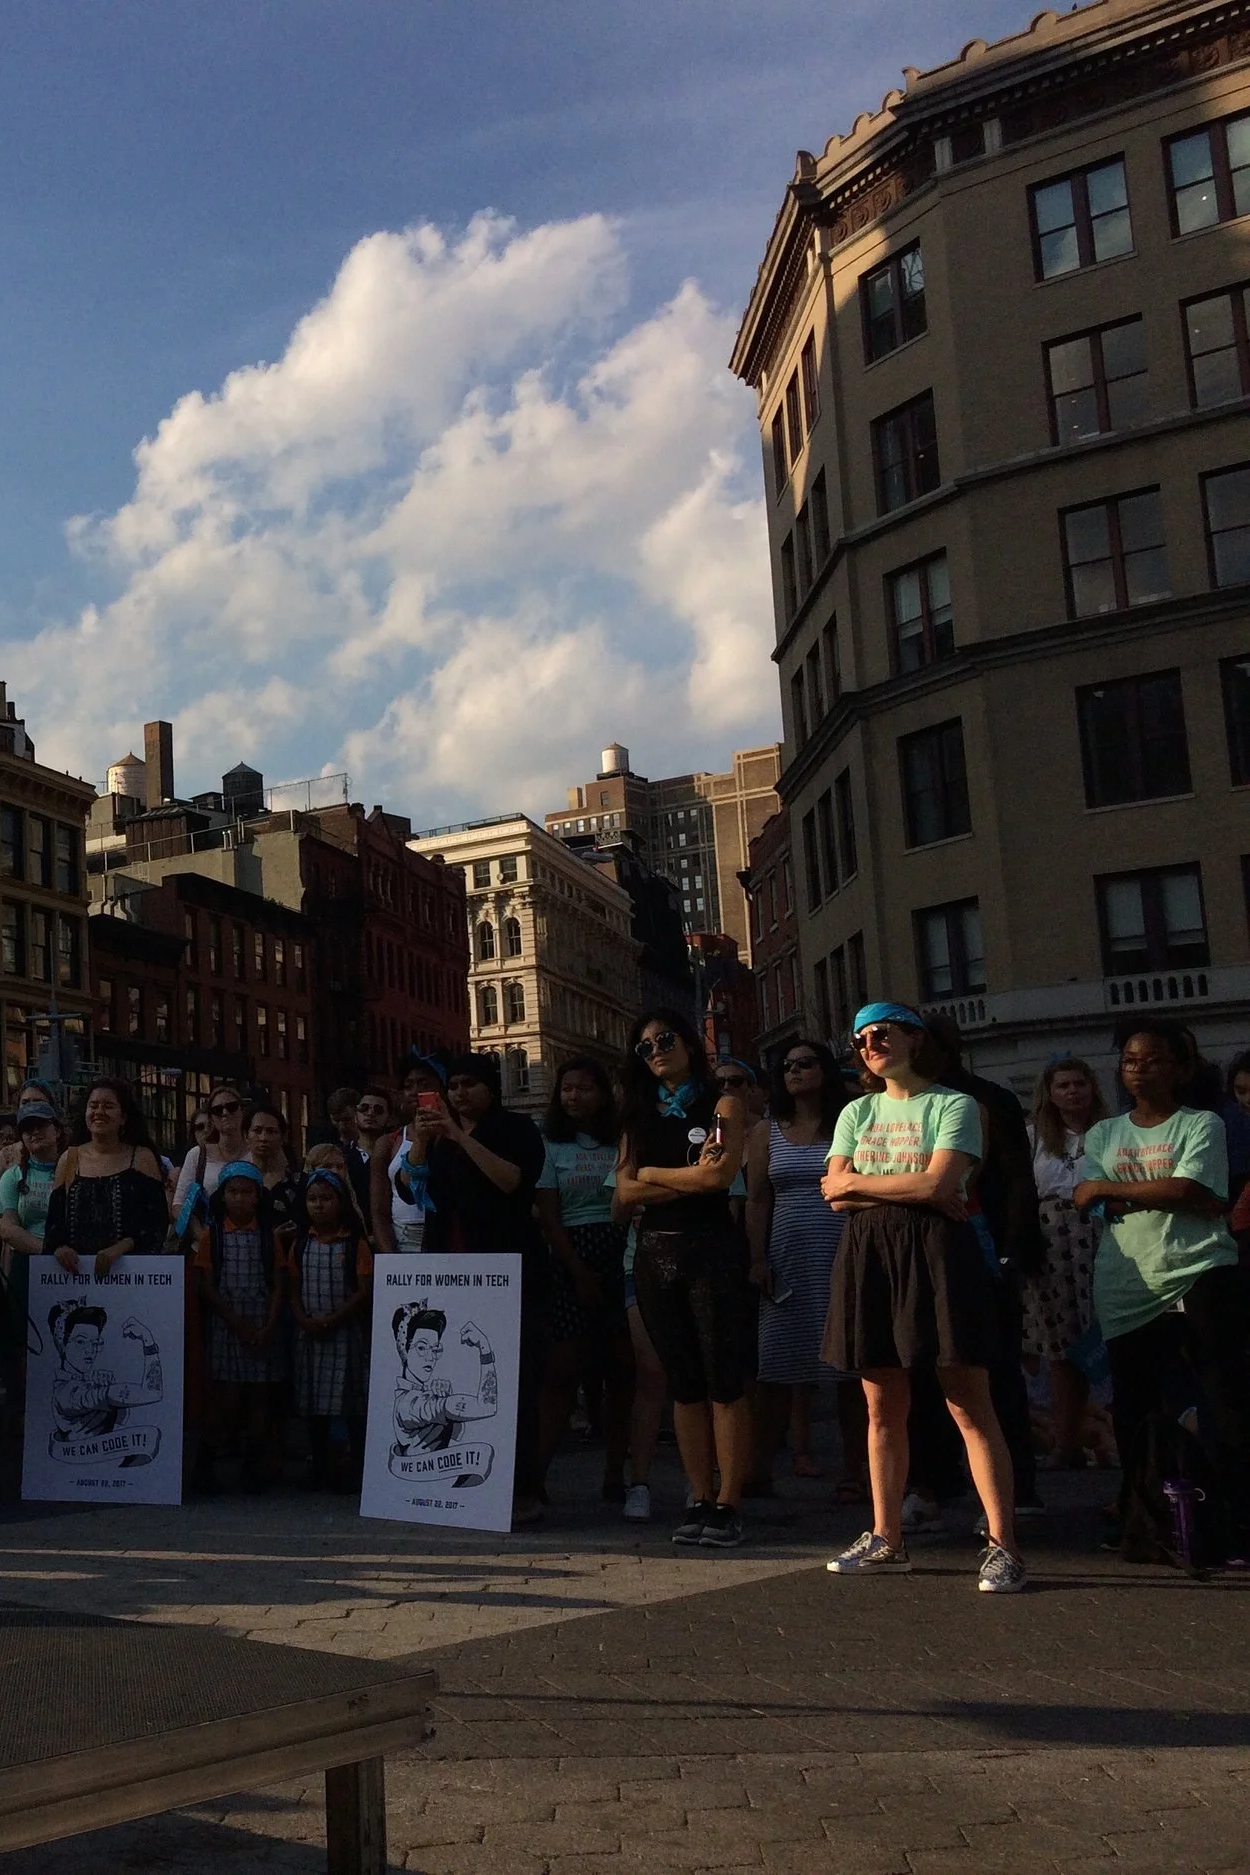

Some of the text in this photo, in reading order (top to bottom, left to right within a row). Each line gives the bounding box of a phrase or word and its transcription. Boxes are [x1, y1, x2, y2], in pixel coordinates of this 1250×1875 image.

[41, 1273, 172, 1285] RALLY FOR WOMEN IN TECH
[386, 1274, 509, 1287] RALLY FOR WOMEN IN TECH
[62, 1433, 147, 1456] WE CAN CODE IT!
[401, 1451, 480, 1472] WE CAN CODE IT!
[76, 1479, 99, 1487] AUGUST
[411, 1498, 433, 1507] AUGUST
[445, 1501, 458, 1509] 2017
